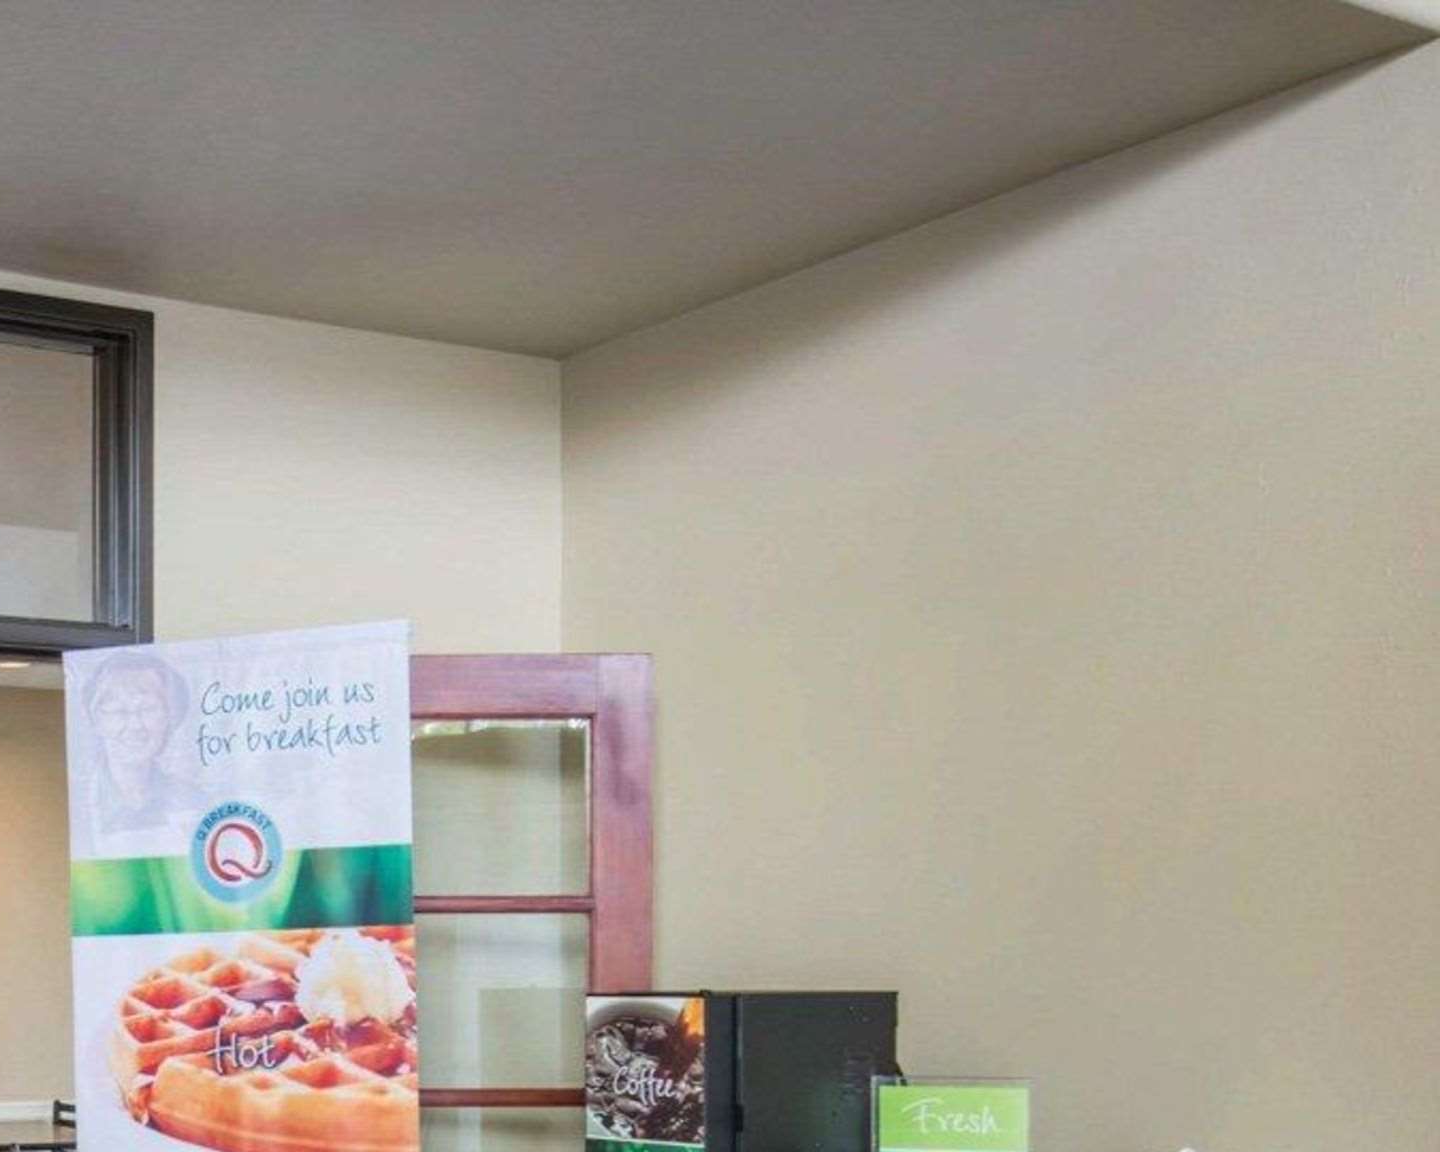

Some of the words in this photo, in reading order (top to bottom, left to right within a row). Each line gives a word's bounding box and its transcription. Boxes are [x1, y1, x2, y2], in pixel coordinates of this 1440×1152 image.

[201, 682, 272, 715] Come
[278, 678, 331, 723] join
[342, 681, 375, 704] us
[196, 724, 238, 767] for
[246, 713, 382, 757] breakfast
[207, 823, 272, 881] Q
[206, 1025, 276, 1076] Hot
[613, 1065, 676, 1106] Coffee
[901, 1098, 999, 1134] Fresh
